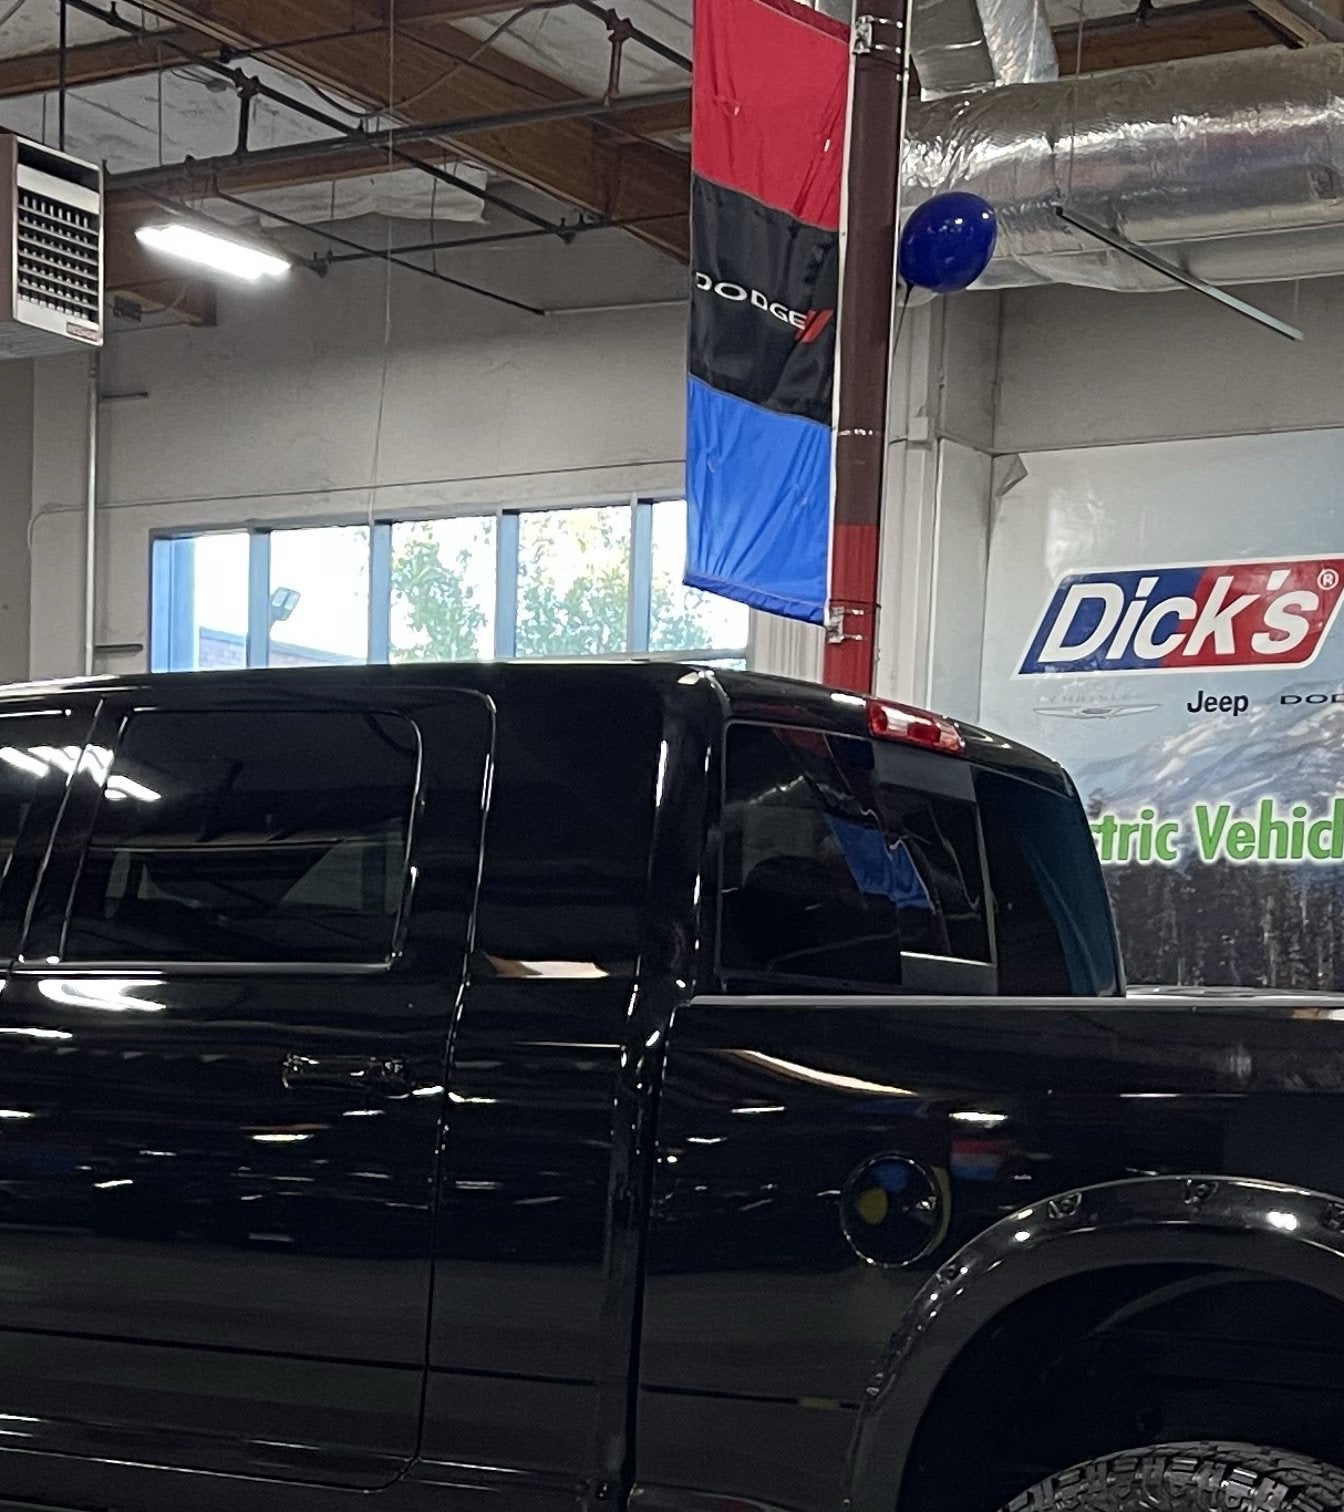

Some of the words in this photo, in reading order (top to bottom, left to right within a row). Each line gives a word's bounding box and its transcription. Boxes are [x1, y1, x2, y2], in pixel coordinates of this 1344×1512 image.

[695, 271, 807, 330] DODGE
[1037, 569, 1320, 663] Dick's
[1187, 690, 1249, 717] Jeep
